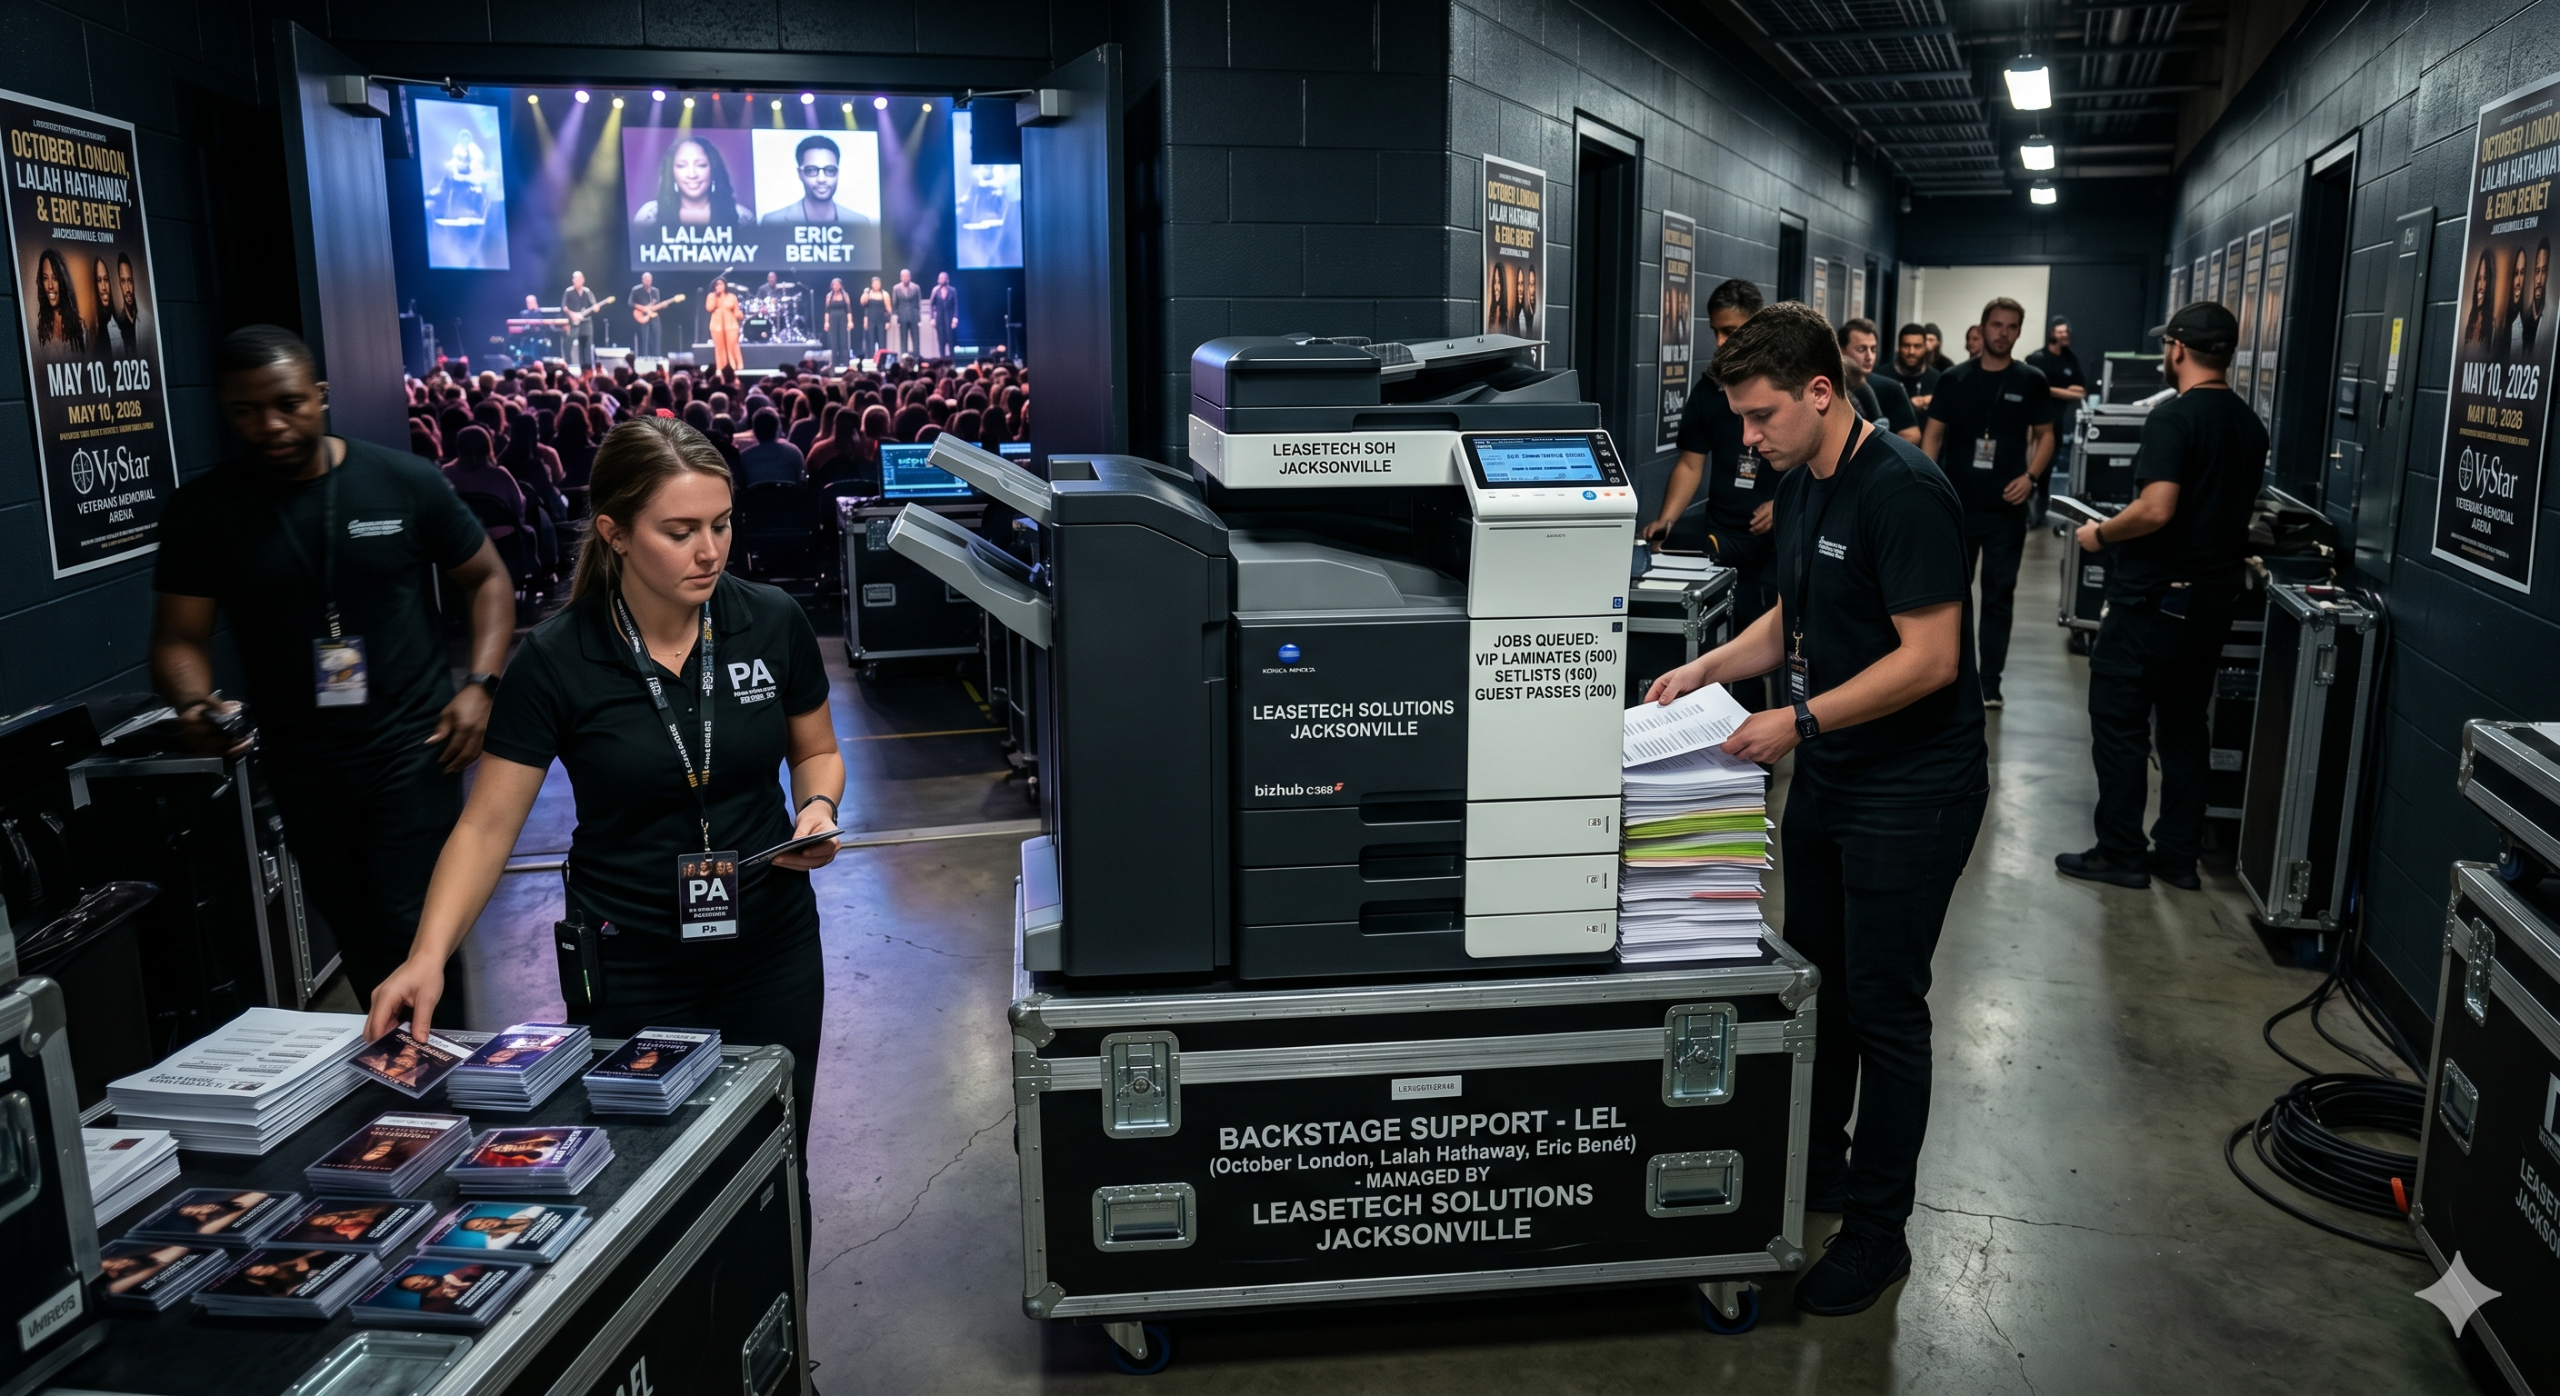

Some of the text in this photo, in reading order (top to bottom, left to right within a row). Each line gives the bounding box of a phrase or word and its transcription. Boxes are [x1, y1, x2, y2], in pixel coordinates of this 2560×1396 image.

[2482, 125, 2524, 163] OCTOBER
[2524, 111, 2560, 150] LONDO
[11, 129, 76, 167] OCTOBER
[77, 143, 130, 180] LONDON,
[16, 161, 132, 208] LALAH HATHAWAY,
[2480, 161, 2510, 193] LALAH
[37, 195, 49, 222] &
[50, 197, 81, 226] ERIC
[2485, 195, 2494, 221] &
[2494, 189, 2517, 219] ERIC
[661, 225, 733, 244] LALAH
[794, 225, 843, 244] ERIC
[639, 244, 759, 263] HATHAWAY
[785, 244, 855, 263] BENET
[46, 359, 151, 398] MAY 10, 2026
[2461, 362, 2540, 403] MAY 10, 2026
[68, 400, 142, 425] MAY 10, 2026
[2467, 404, 2487, 423] MAY
[1273, 441, 1395, 456] LEASETECH SOH
[92, 445, 150, 494] VyStar
[1279, 459, 1392, 475] JACKSONVILLE
[2475, 451, 2518, 499] VyStar
[77, 495, 118, 515] VETERANS
[1494, 632, 1599, 648] JOBS QUEUED:
[1475, 649, 1617, 666] VIP LAMINATES (500)
[727, 658, 776, 690] PA
[1494, 668, 1561, 683] SETLISTS
[1475, 684, 1617, 701] GUEST PASSES (200)
[1253, 699, 1455, 720] LEASETECH SOLUTIONS
[1290, 720, 1418, 740] JACKSONVILLE
[1254, 783, 1304, 797] bizhub
[689, 877, 729, 903] PA
[1219, 1118, 1401, 1151] BACKSTAGE
[1410, 1109, 1549, 1141] SUPPORT
[1575, 1106, 1627, 1131] LEL
[1209, 1133, 1637, 1178] (October London, Lalah Hathaway, Eric Benét)
[1366, 1168, 1460, 1189] MANAGED
[1465, 1166, 1491, 1183] BY
[1253, 1183, 1594, 1225] LEASETECH SOLUTIONS
[2520, 1157, 2560, 1227] LEASET
[1316, 1216, 1532, 1251] JACKSONVILLE
